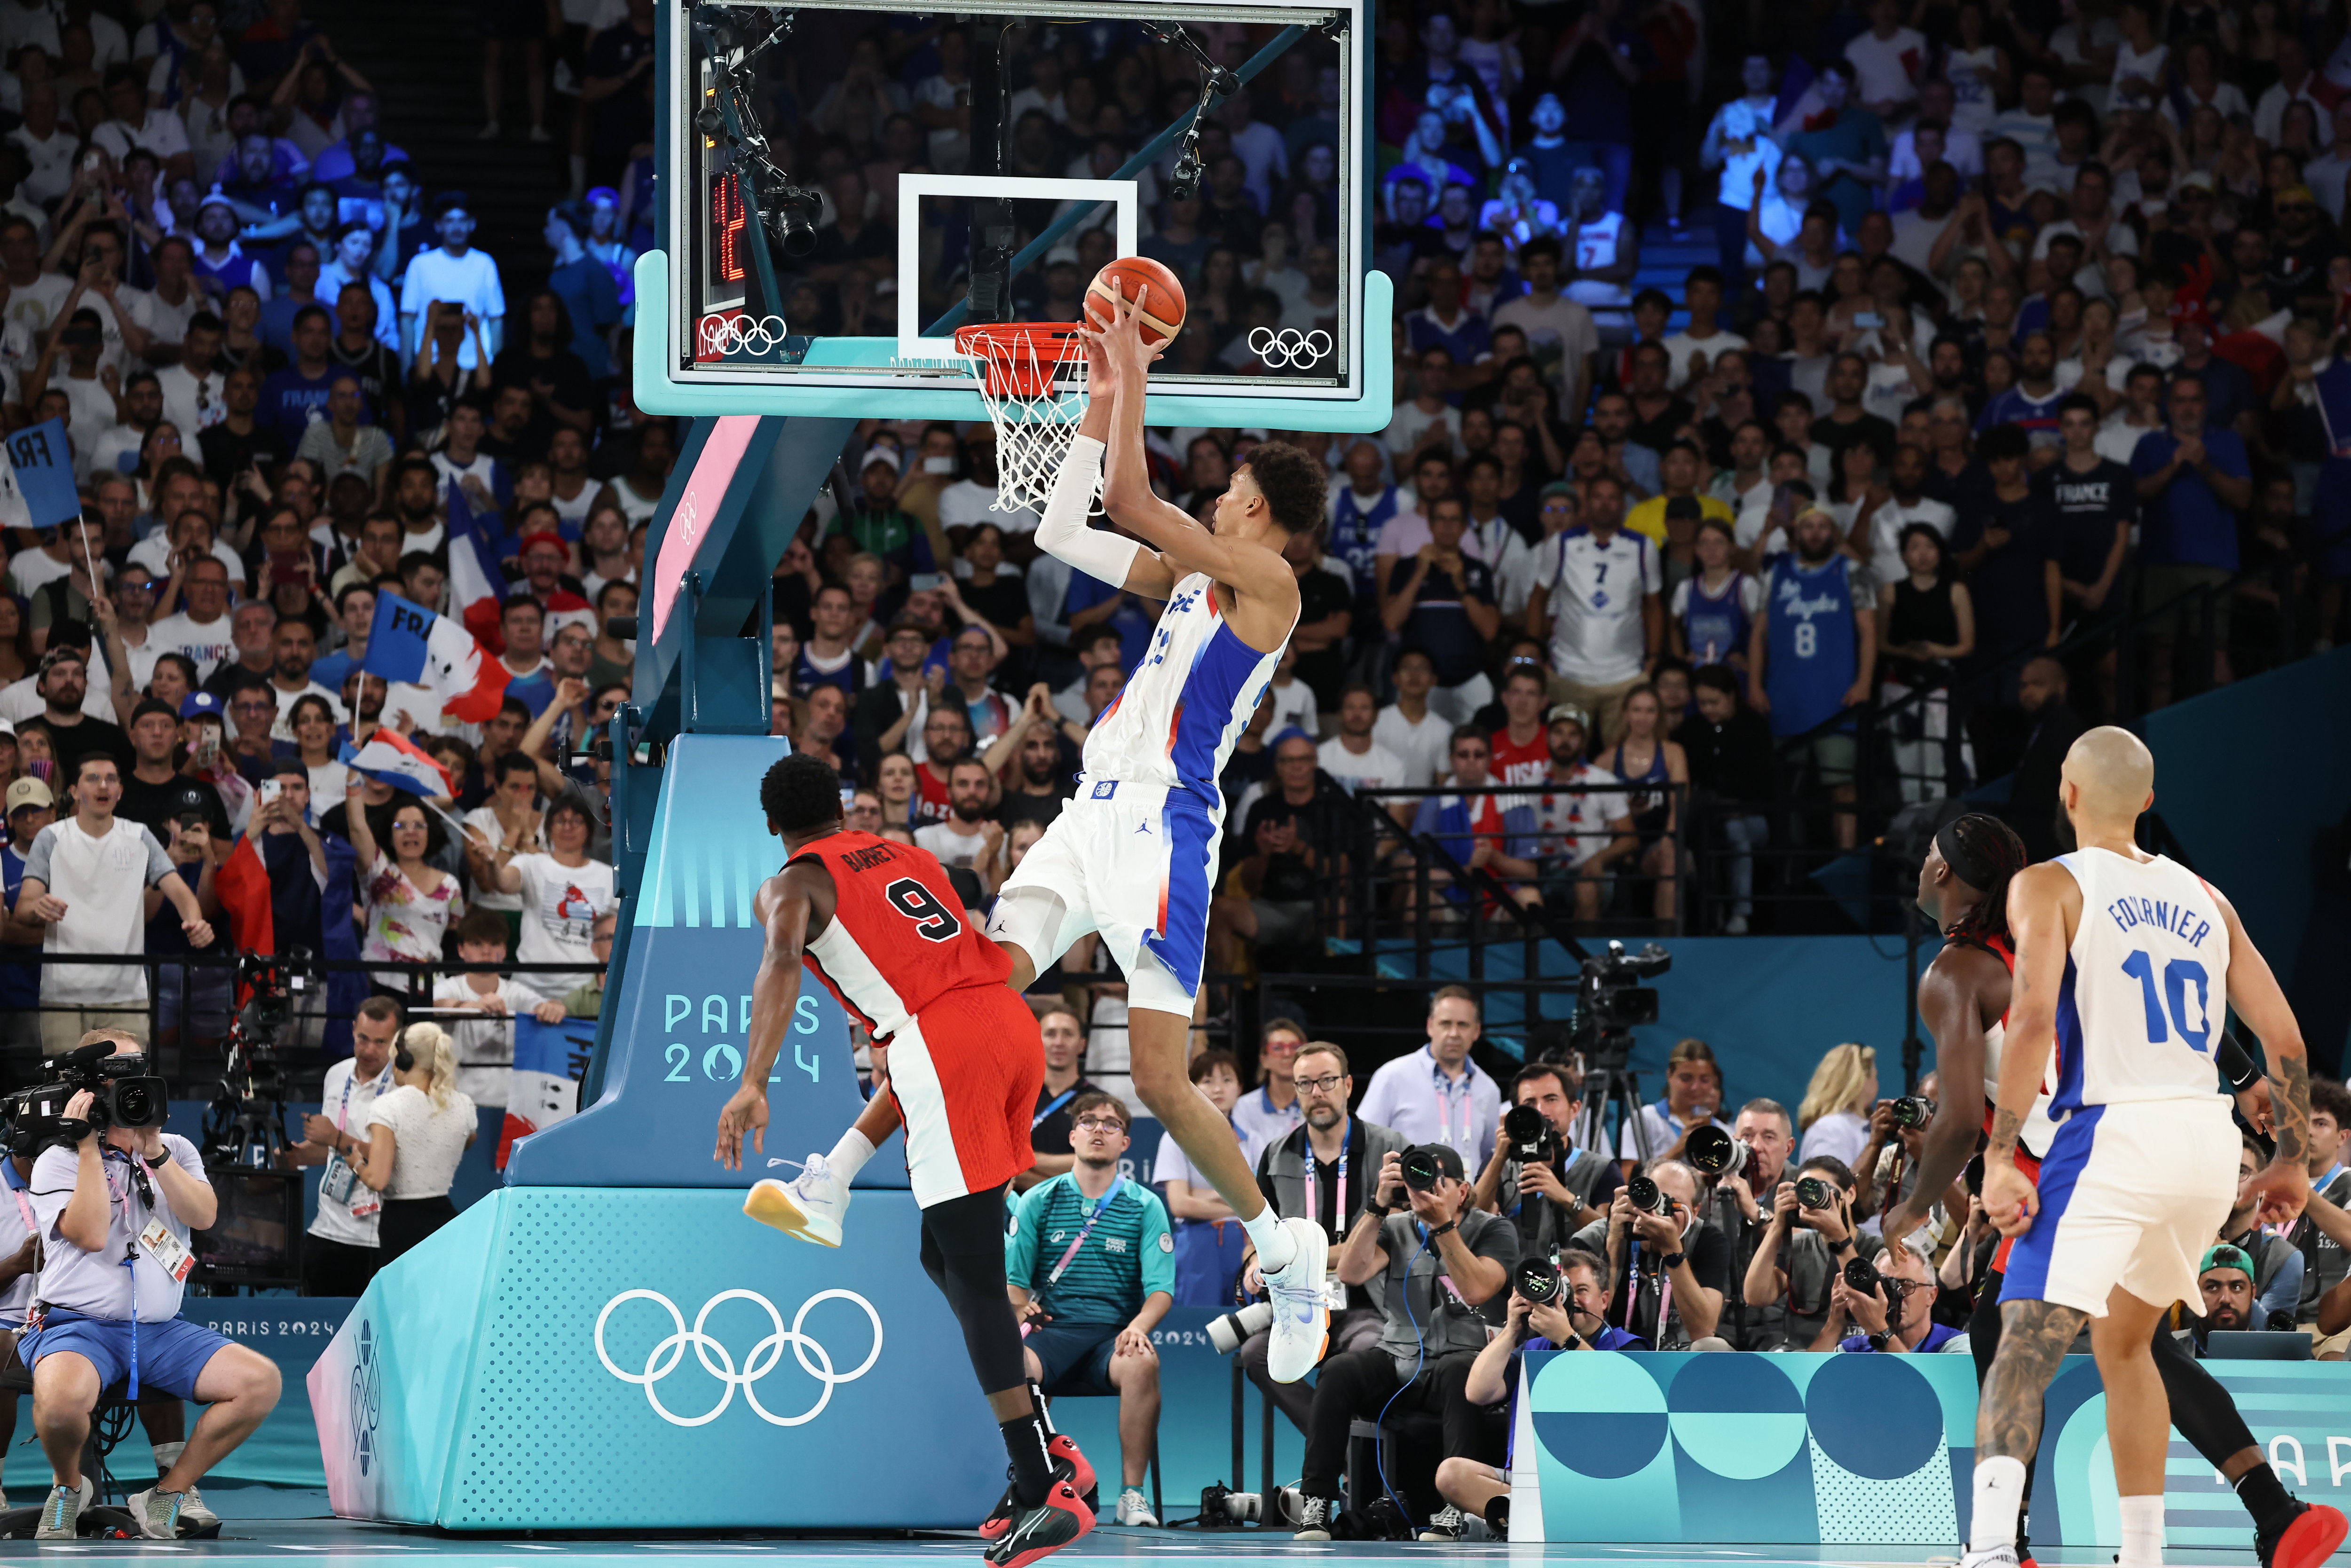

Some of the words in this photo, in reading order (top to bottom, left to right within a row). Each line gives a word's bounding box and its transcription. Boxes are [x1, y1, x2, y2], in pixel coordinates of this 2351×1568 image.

[2055, 482, 2110, 504] FRANCE
[1595, 562, 1607, 583] 7
[1794, 622, 1817, 658] 8
[885, 876, 961, 943] 9
[2108, 896, 2210, 947] FOURNIER
[2122, 950, 2210, 1052] 10
[278, 1322, 333, 1335] 2024
[1152, 1331, 1206, 1345] 2024
